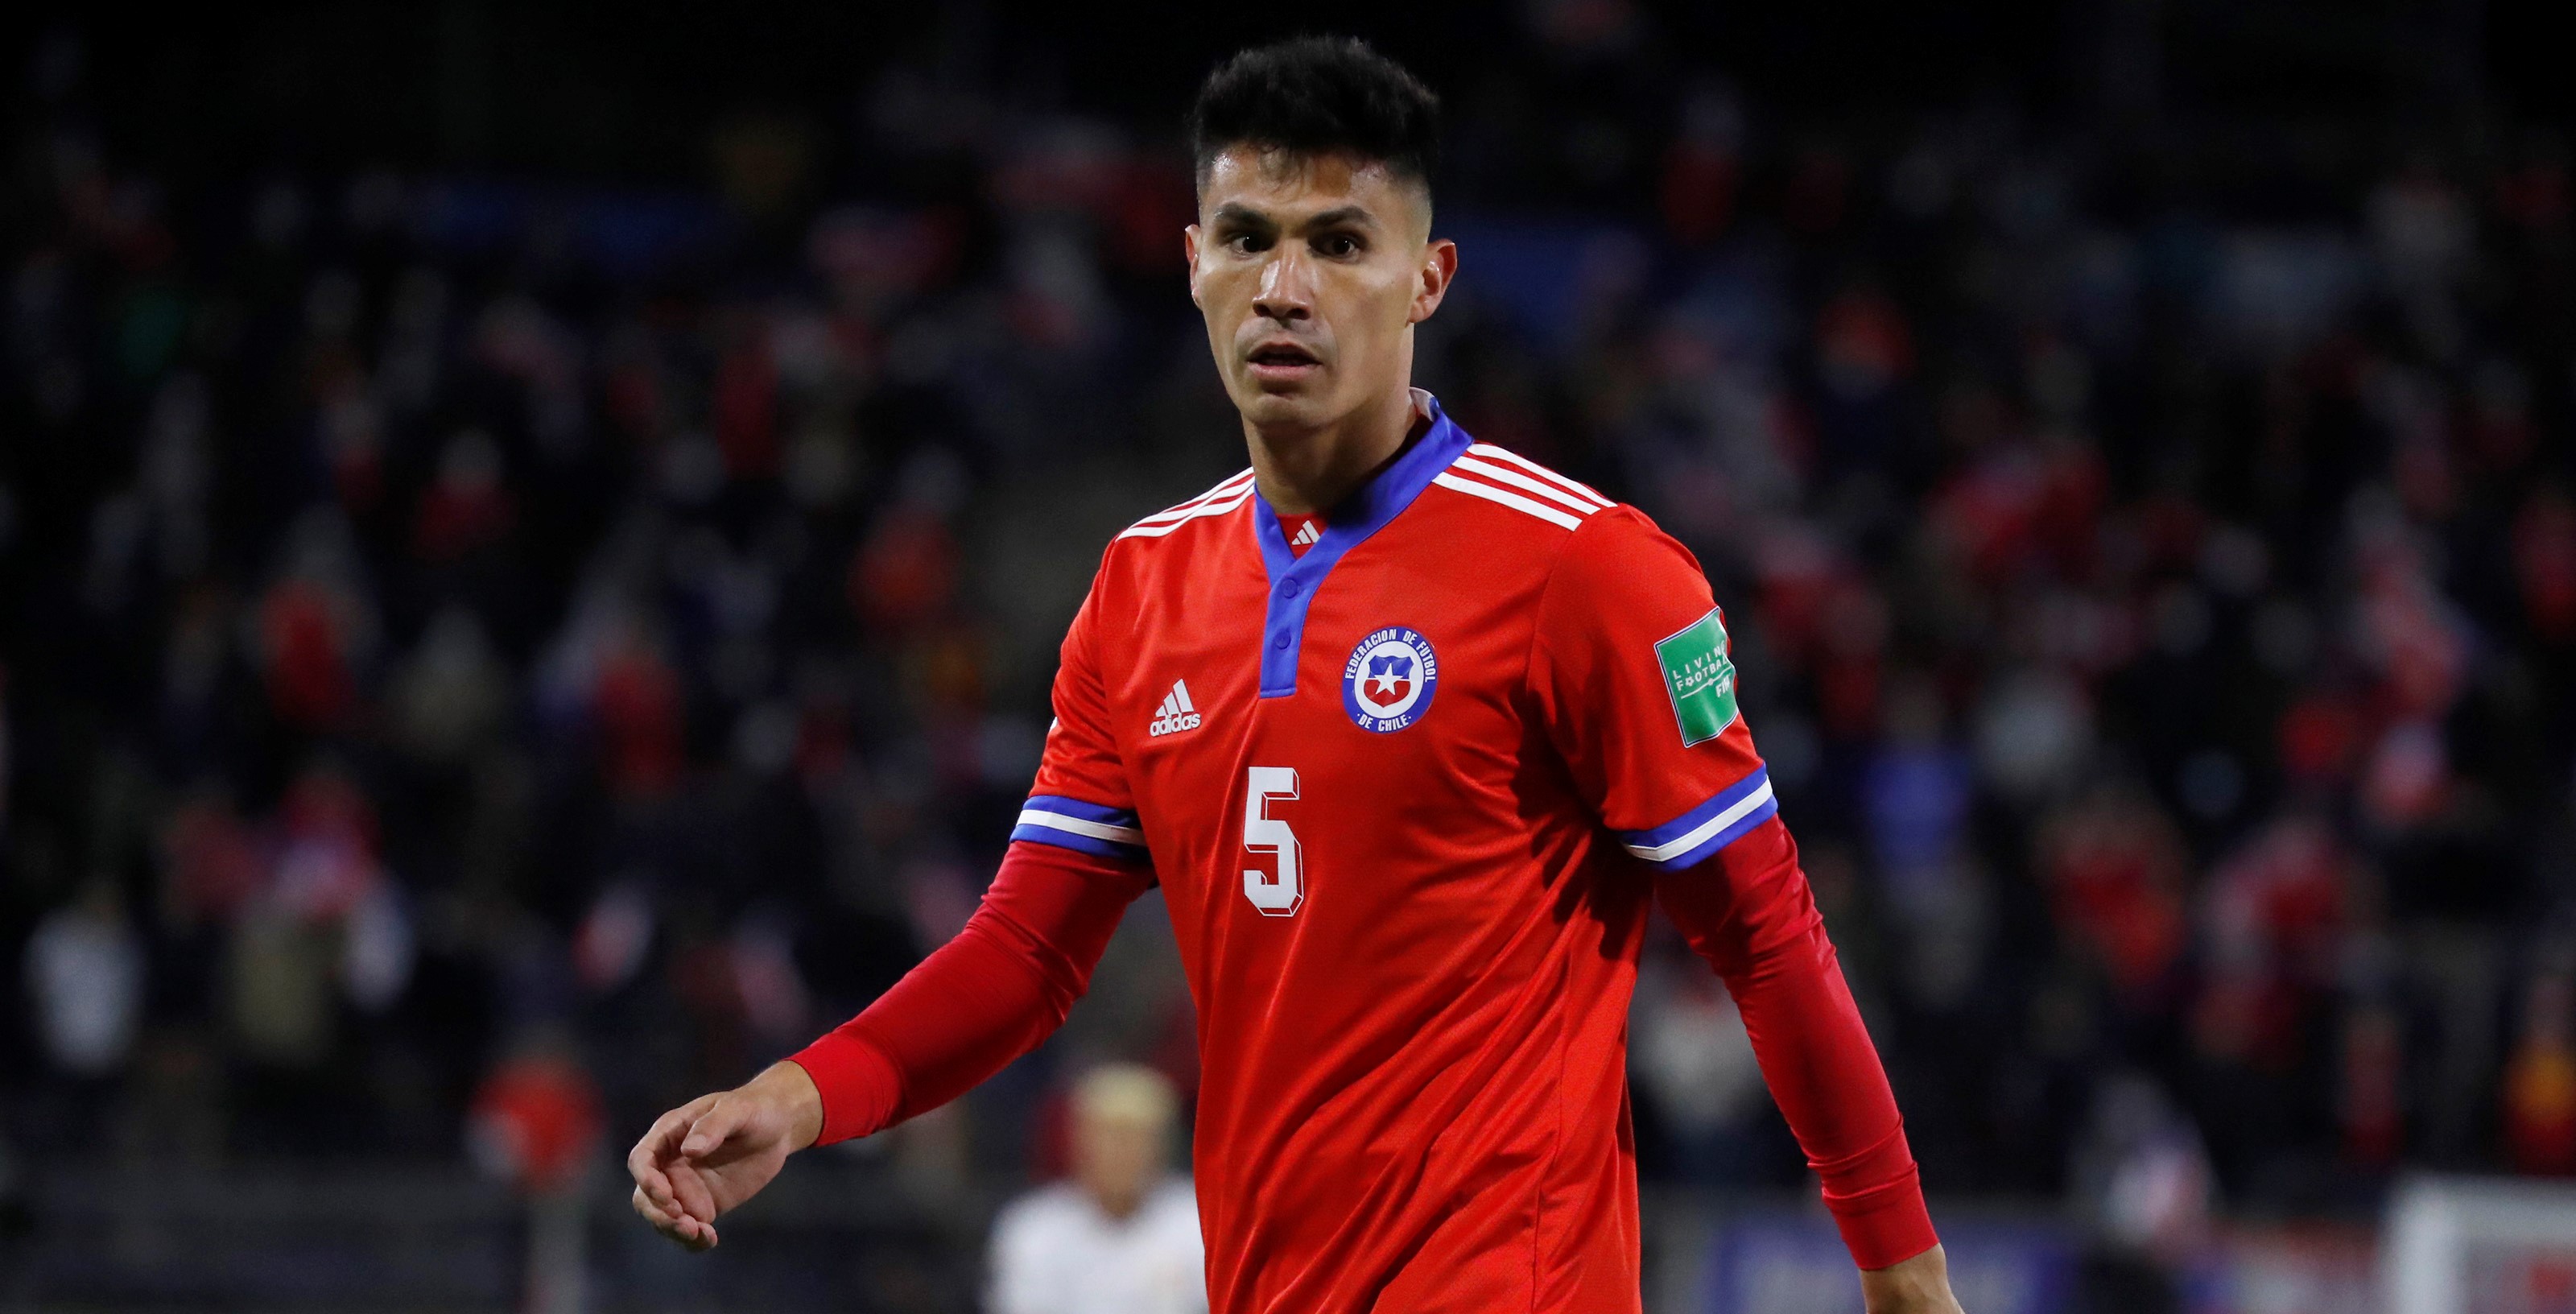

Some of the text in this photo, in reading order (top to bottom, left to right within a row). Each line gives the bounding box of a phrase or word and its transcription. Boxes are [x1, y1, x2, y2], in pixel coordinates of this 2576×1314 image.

[1345, 629, 1436, 683] FEDERACION DE FUTBOL
[1150, 713, 1201, 737] adidas
[1244, 766, 1304, 916] 5
